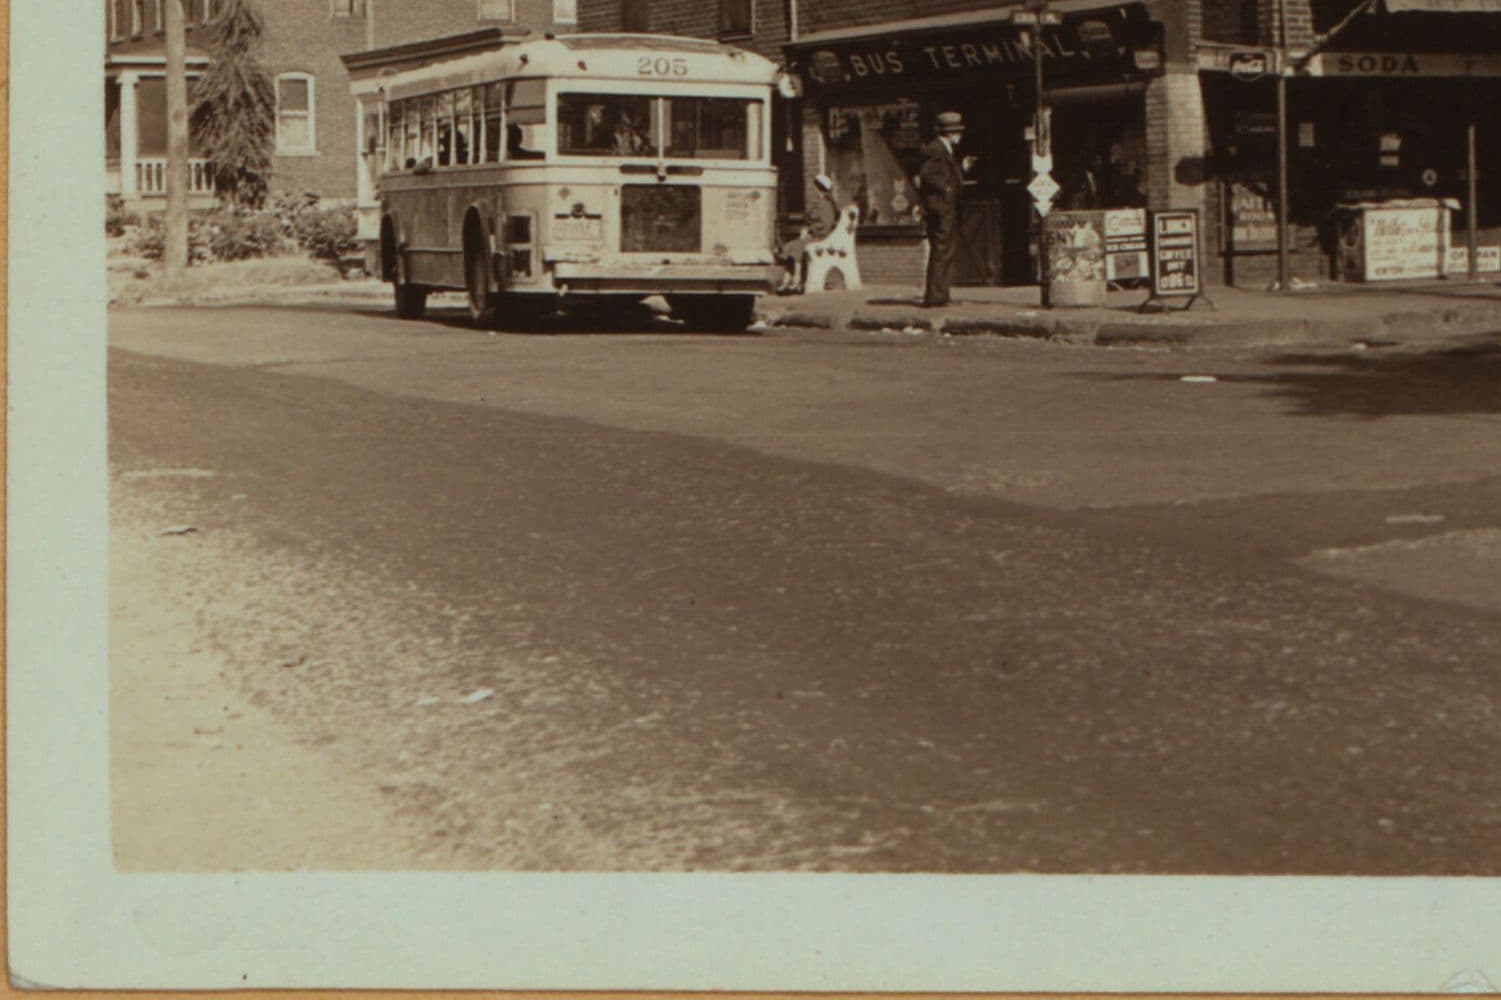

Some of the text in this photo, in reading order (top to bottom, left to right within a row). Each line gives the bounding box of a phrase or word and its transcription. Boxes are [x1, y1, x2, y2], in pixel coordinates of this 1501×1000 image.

[849, 33, 1075, 77] BUS TERMINAL
[1337, 55, 1420, 74] SODA
[637, 56, 689, 77] 205
